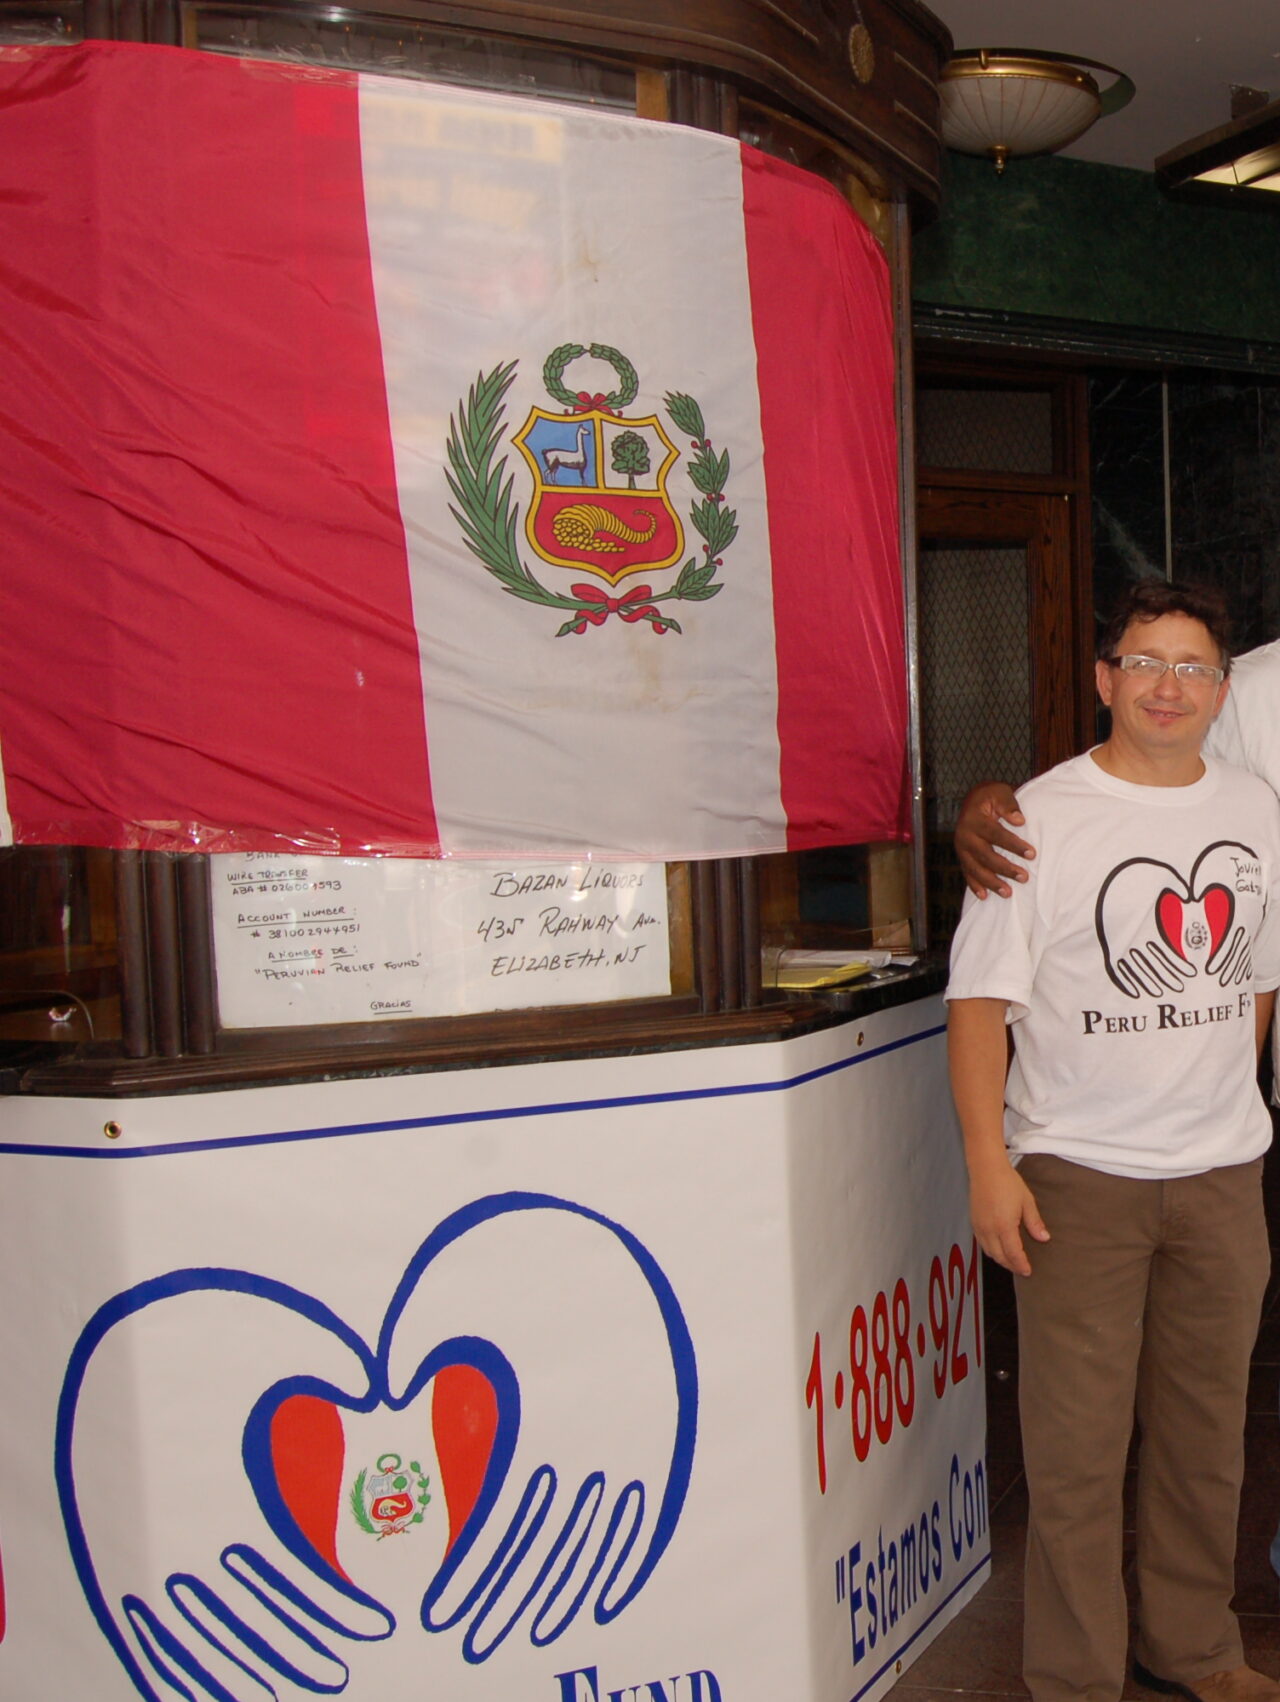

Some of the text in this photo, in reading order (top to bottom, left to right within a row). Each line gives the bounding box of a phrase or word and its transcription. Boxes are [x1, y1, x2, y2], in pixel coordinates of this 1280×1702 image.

[227, 872, 254, 882] WIRE
[232, 885, 254, 896] ABA
[258, 885, 267, 893] #
[490, 872, 569, 898] BAZAN
[238, 912, 292, 924] ACCOUNT
[478, 916, 524, 942] 435
[539, 906, 619, 937] RAHWAY
[268, 951, 275, 960] A
[278, 948, 324, 959] NOMBRE
[330, 961, 375, 973] RELIEF
[370, 1000, 413, 1011] GRACIAS
[1082, 992, 1251, 1034] PERU RELIEF F
[835, 1500, 944, 1667] "Estamos
[553, 1665, 723, 1702] FD
